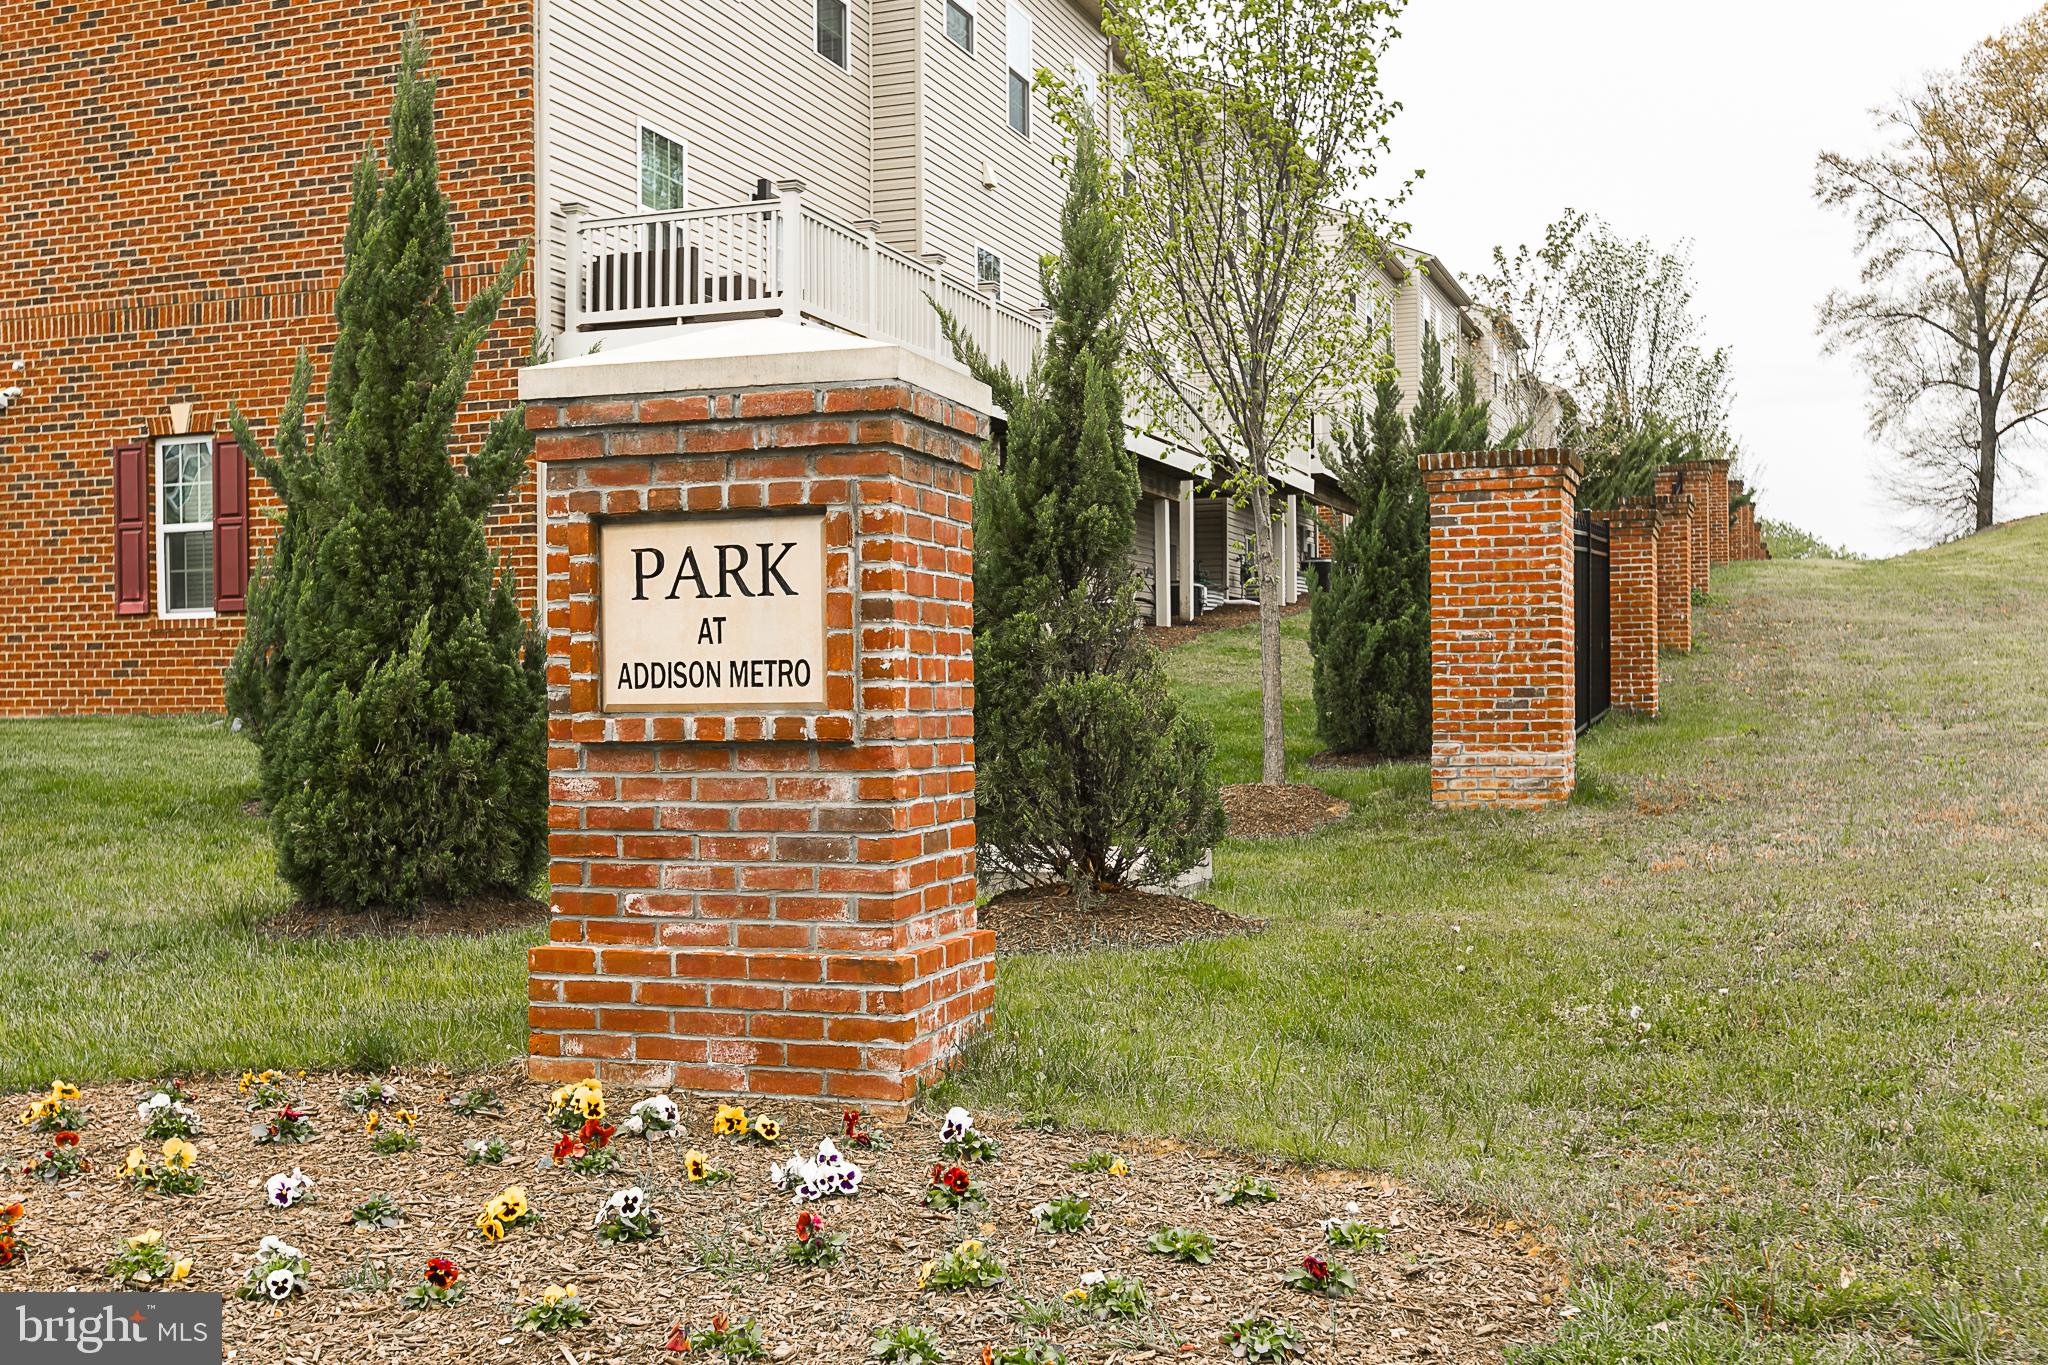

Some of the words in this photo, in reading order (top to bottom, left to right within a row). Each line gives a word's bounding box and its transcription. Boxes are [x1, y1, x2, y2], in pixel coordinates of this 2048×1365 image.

[631, 542, 799, 601] PARK
[697, 616, 727, 645] AT
[617, 660, 721, 690] ADDISON
[729, 658, 811, 688] METRO
